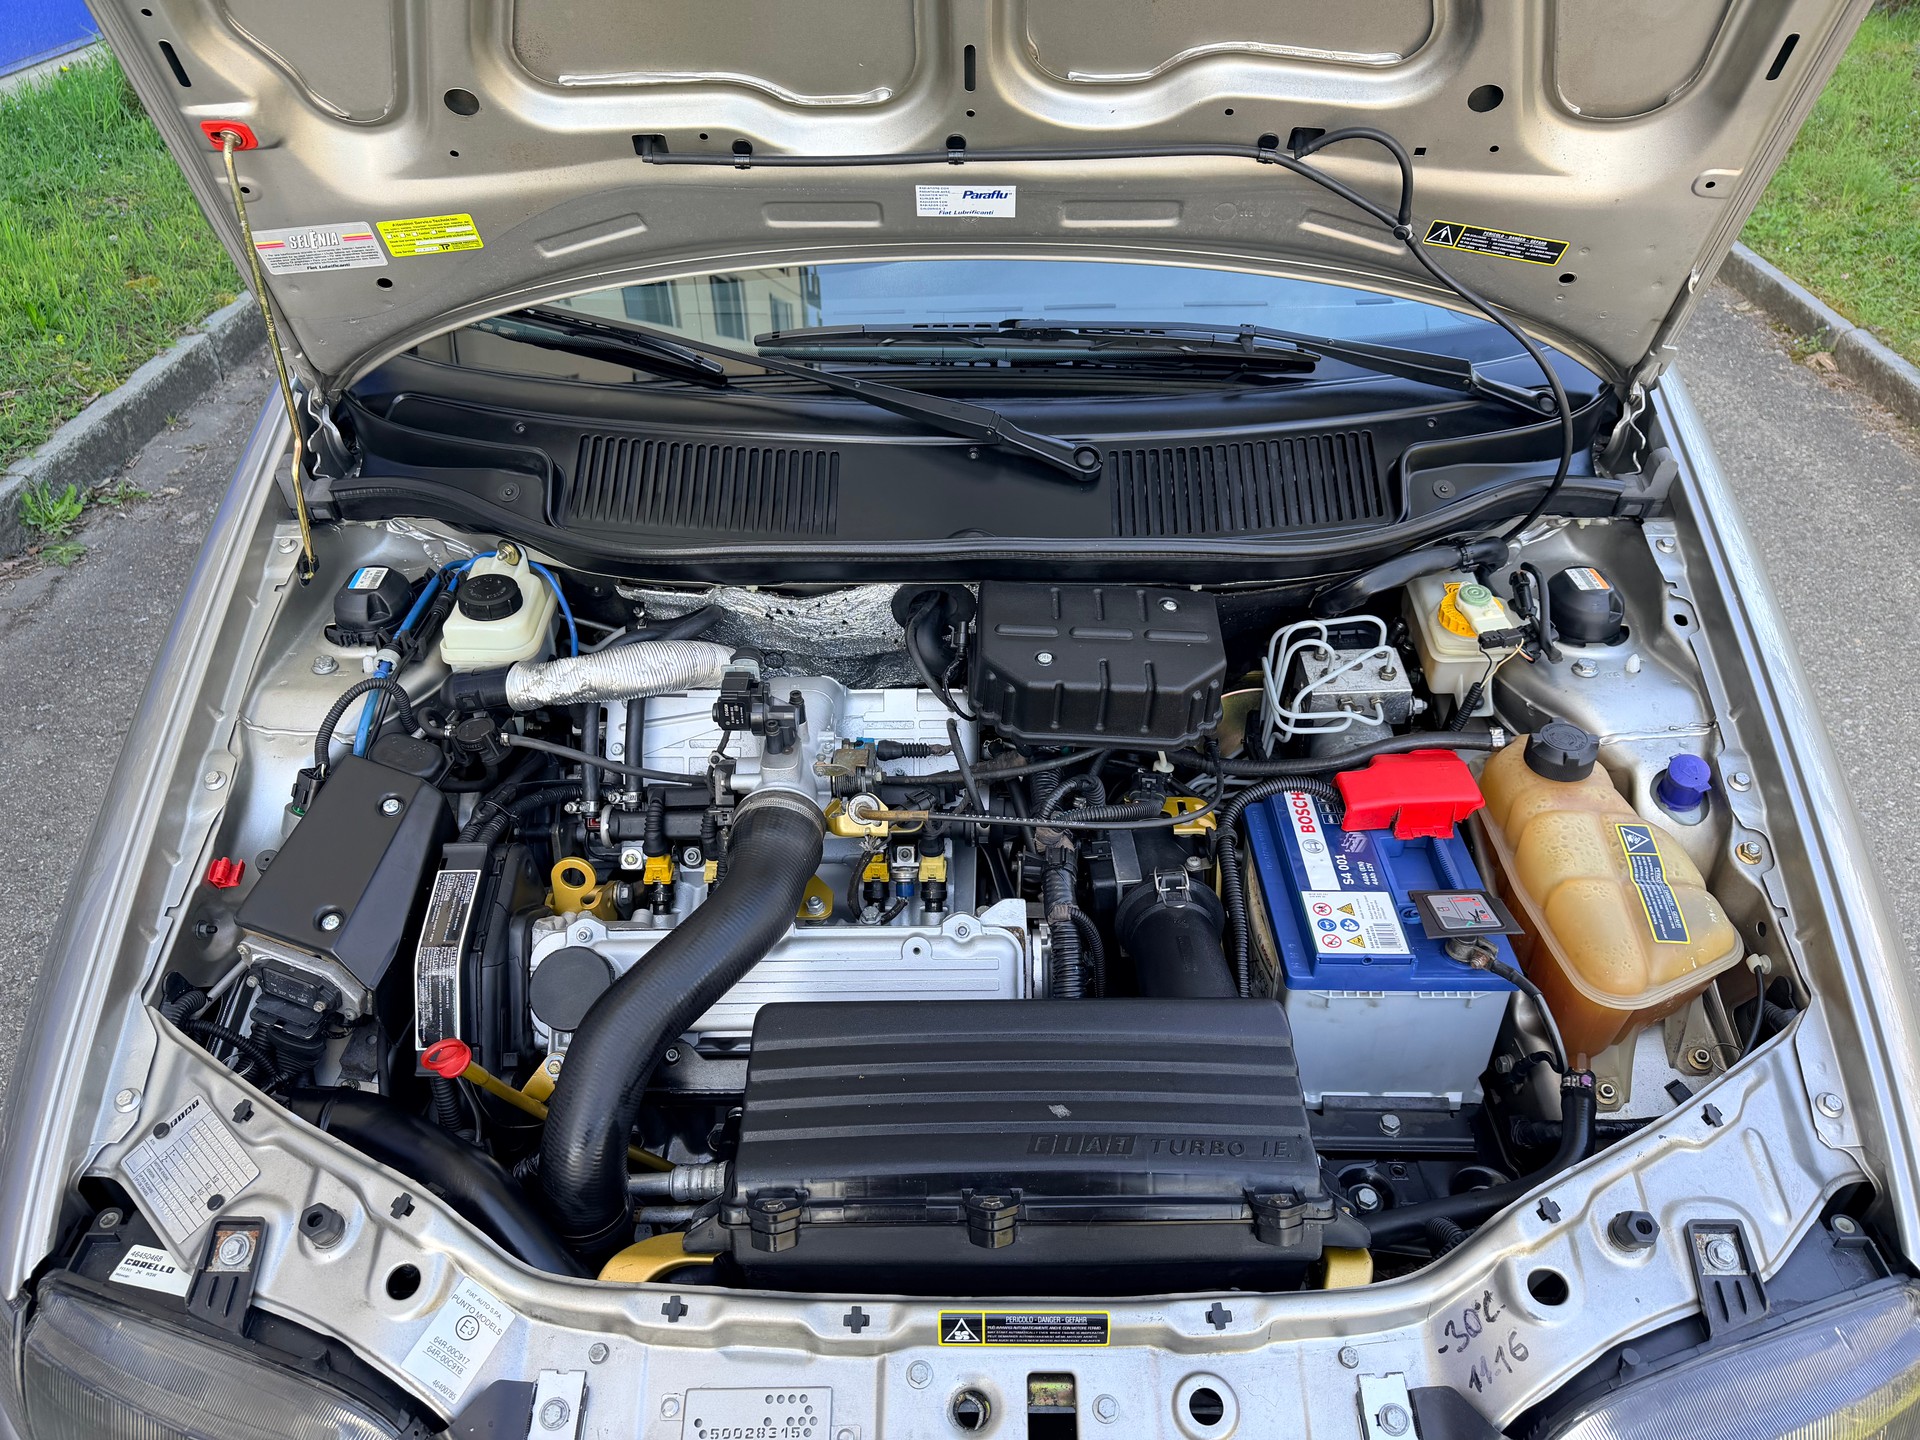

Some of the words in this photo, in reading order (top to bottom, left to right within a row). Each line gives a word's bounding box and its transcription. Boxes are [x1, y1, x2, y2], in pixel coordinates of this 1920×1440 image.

[962, 190, 1008, 199] Paraflu
[1291, 791, 1316, 834] BOSCH
[1337, 854, 1347, 871] 001
[1342, 872, 1354, 885] S4
[170, 1099, 200, 1128] FIAT
[1031, 1135, 1135, 1154] FIAT
[1150, 1138, 1246, 1157] TURBO
[1262, 1140, 1292, 1158] I.E.
[124, 1258, 176, 1274] CARELLO
[130, 1250, 164, 1262] 46450468
[466, 1289, 477, 1301] FIAT
[478, 1298, 490, 1310] AUTO
[451, 1294, 475, 1314] PUNTO
[475, 1311, 503, 1336] MODELS
[426, 1345, 464, 1375] 64R-00C918
[433, 1335, 470, 1365] 64R-00C917
[432, 1379, 457, 1400] 46400785
[710, 1427, 800, 1440] 50028315
